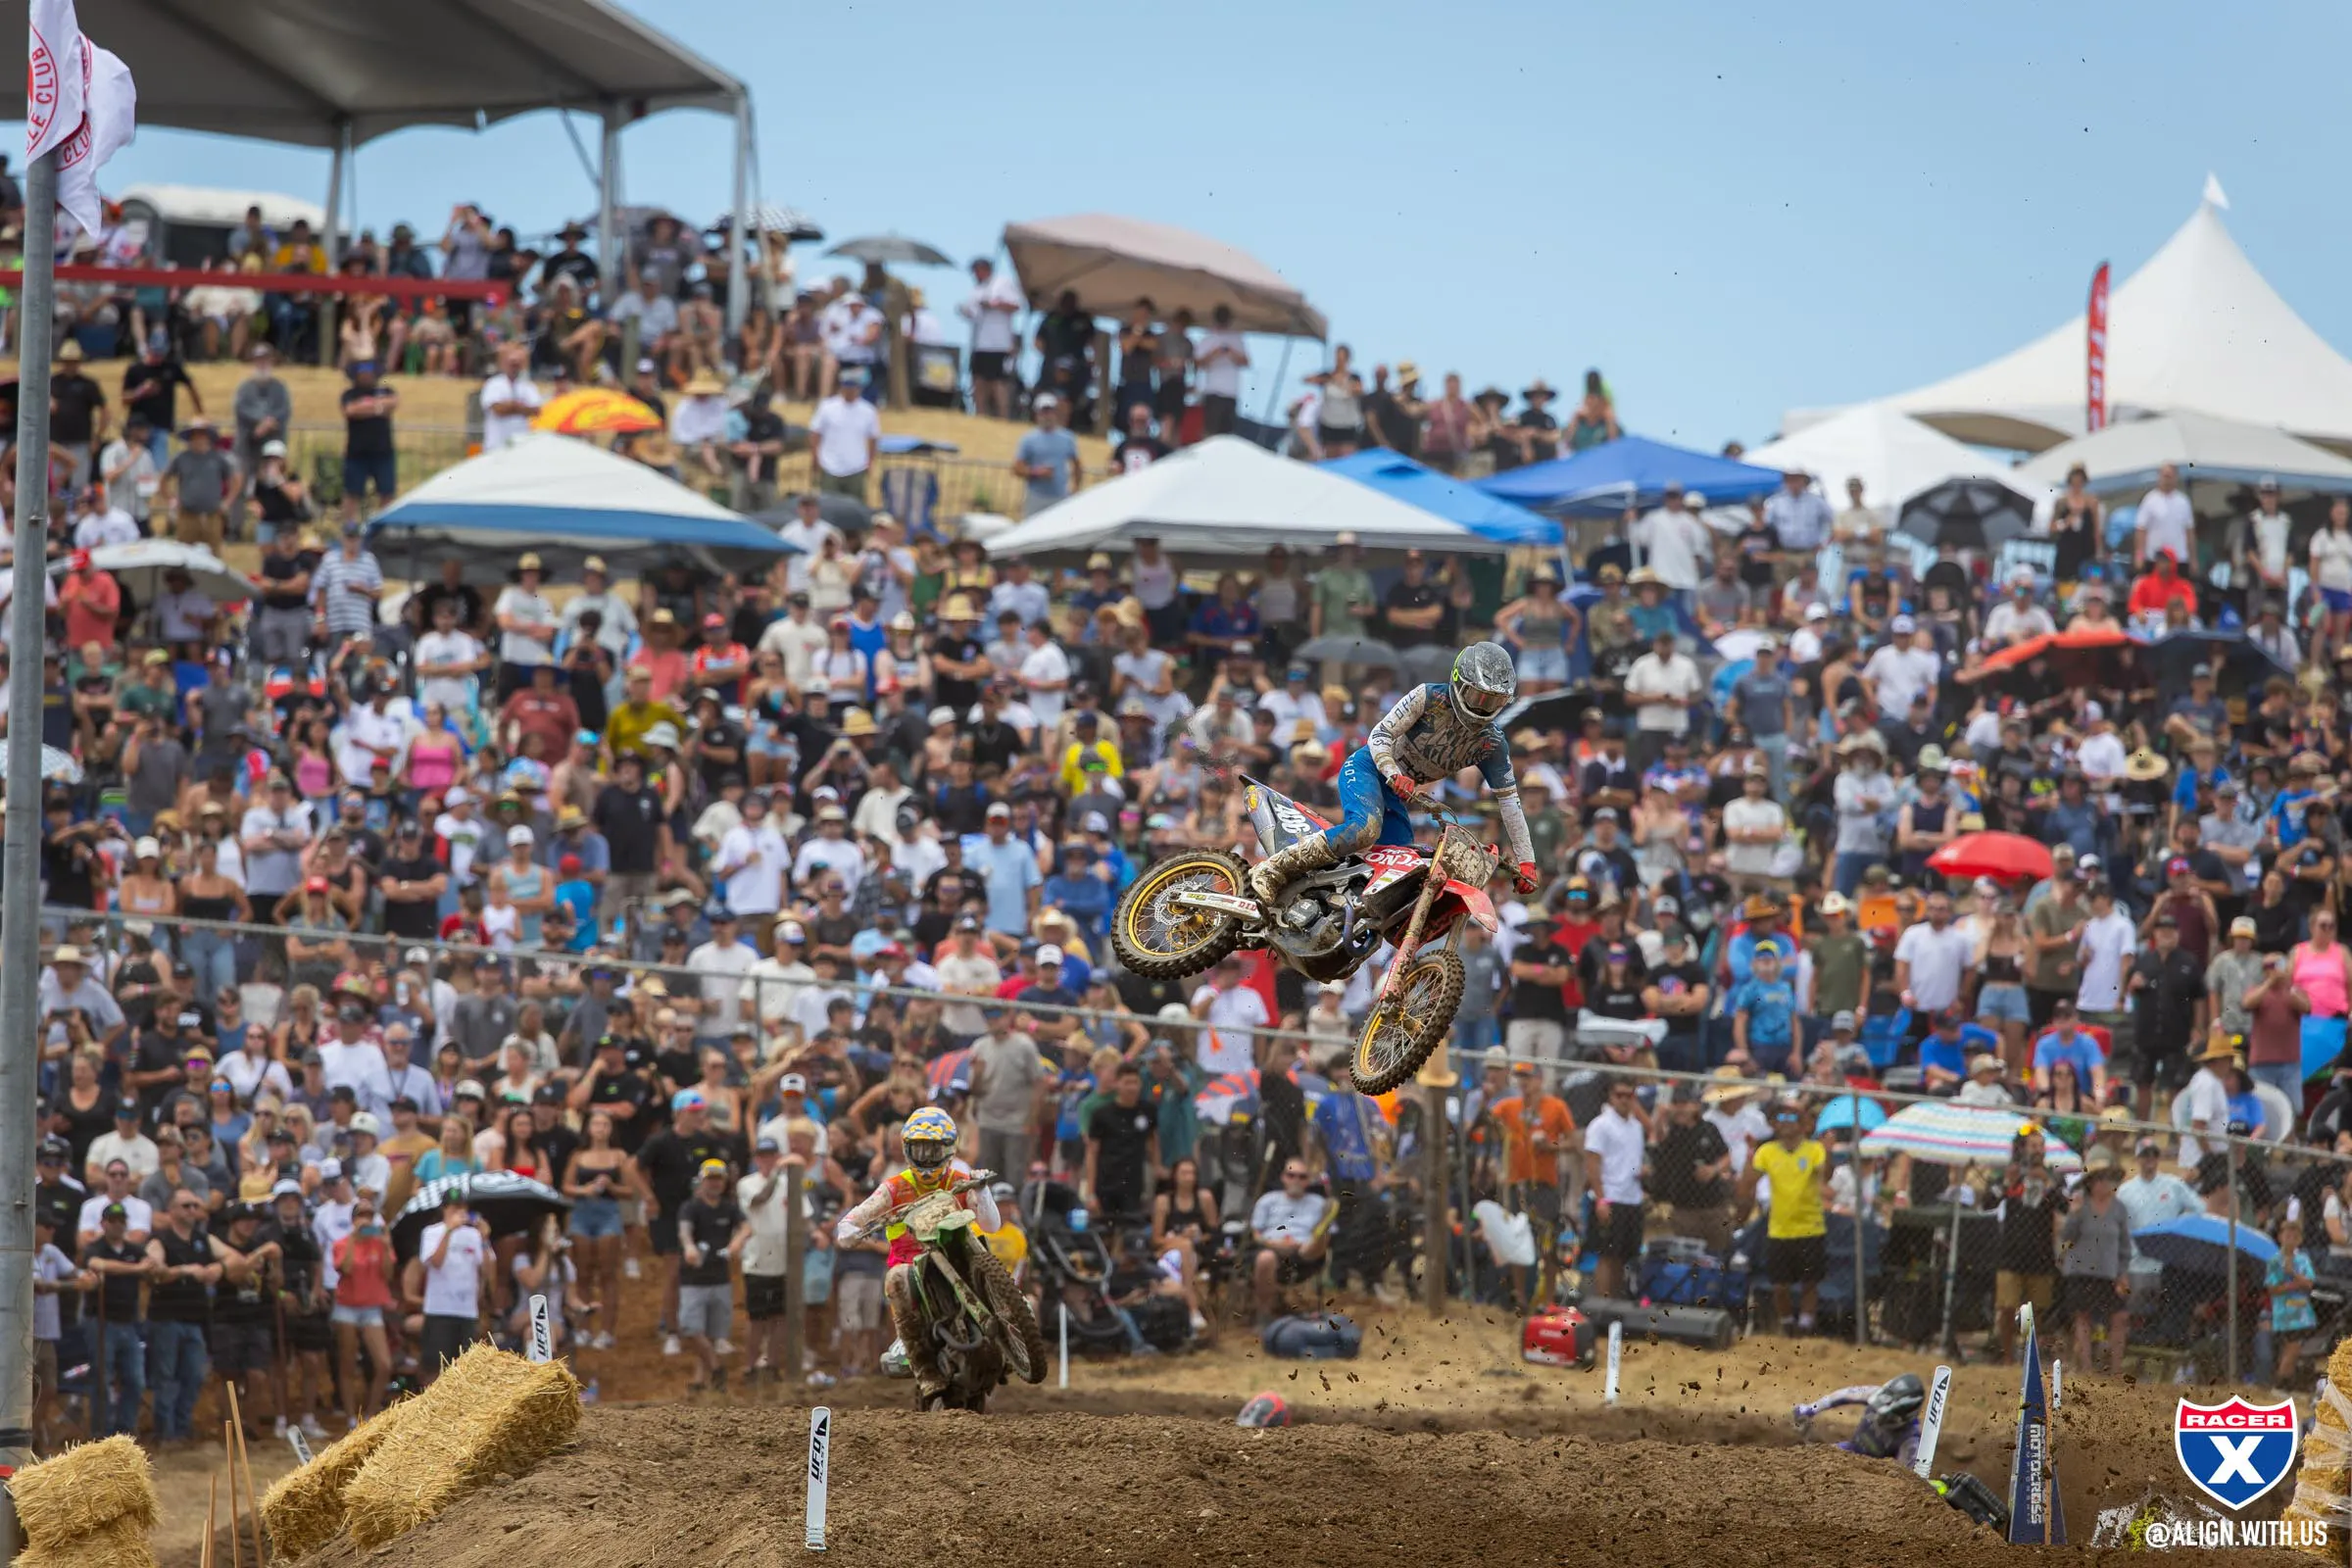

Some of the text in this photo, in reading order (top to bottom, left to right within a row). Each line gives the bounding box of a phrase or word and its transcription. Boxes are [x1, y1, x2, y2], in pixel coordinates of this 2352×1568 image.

[32, 47, 53, 104] CLUB
[1365, 852, 1425, 867] ONDA
[535, 1321, 547, 1357] UFO
[1929, 1391, 1941, 1426] UFO
[810, 1437, 822, 1482] UFO
[2030, 1424, 2041, 1524] MOTOCROSS
